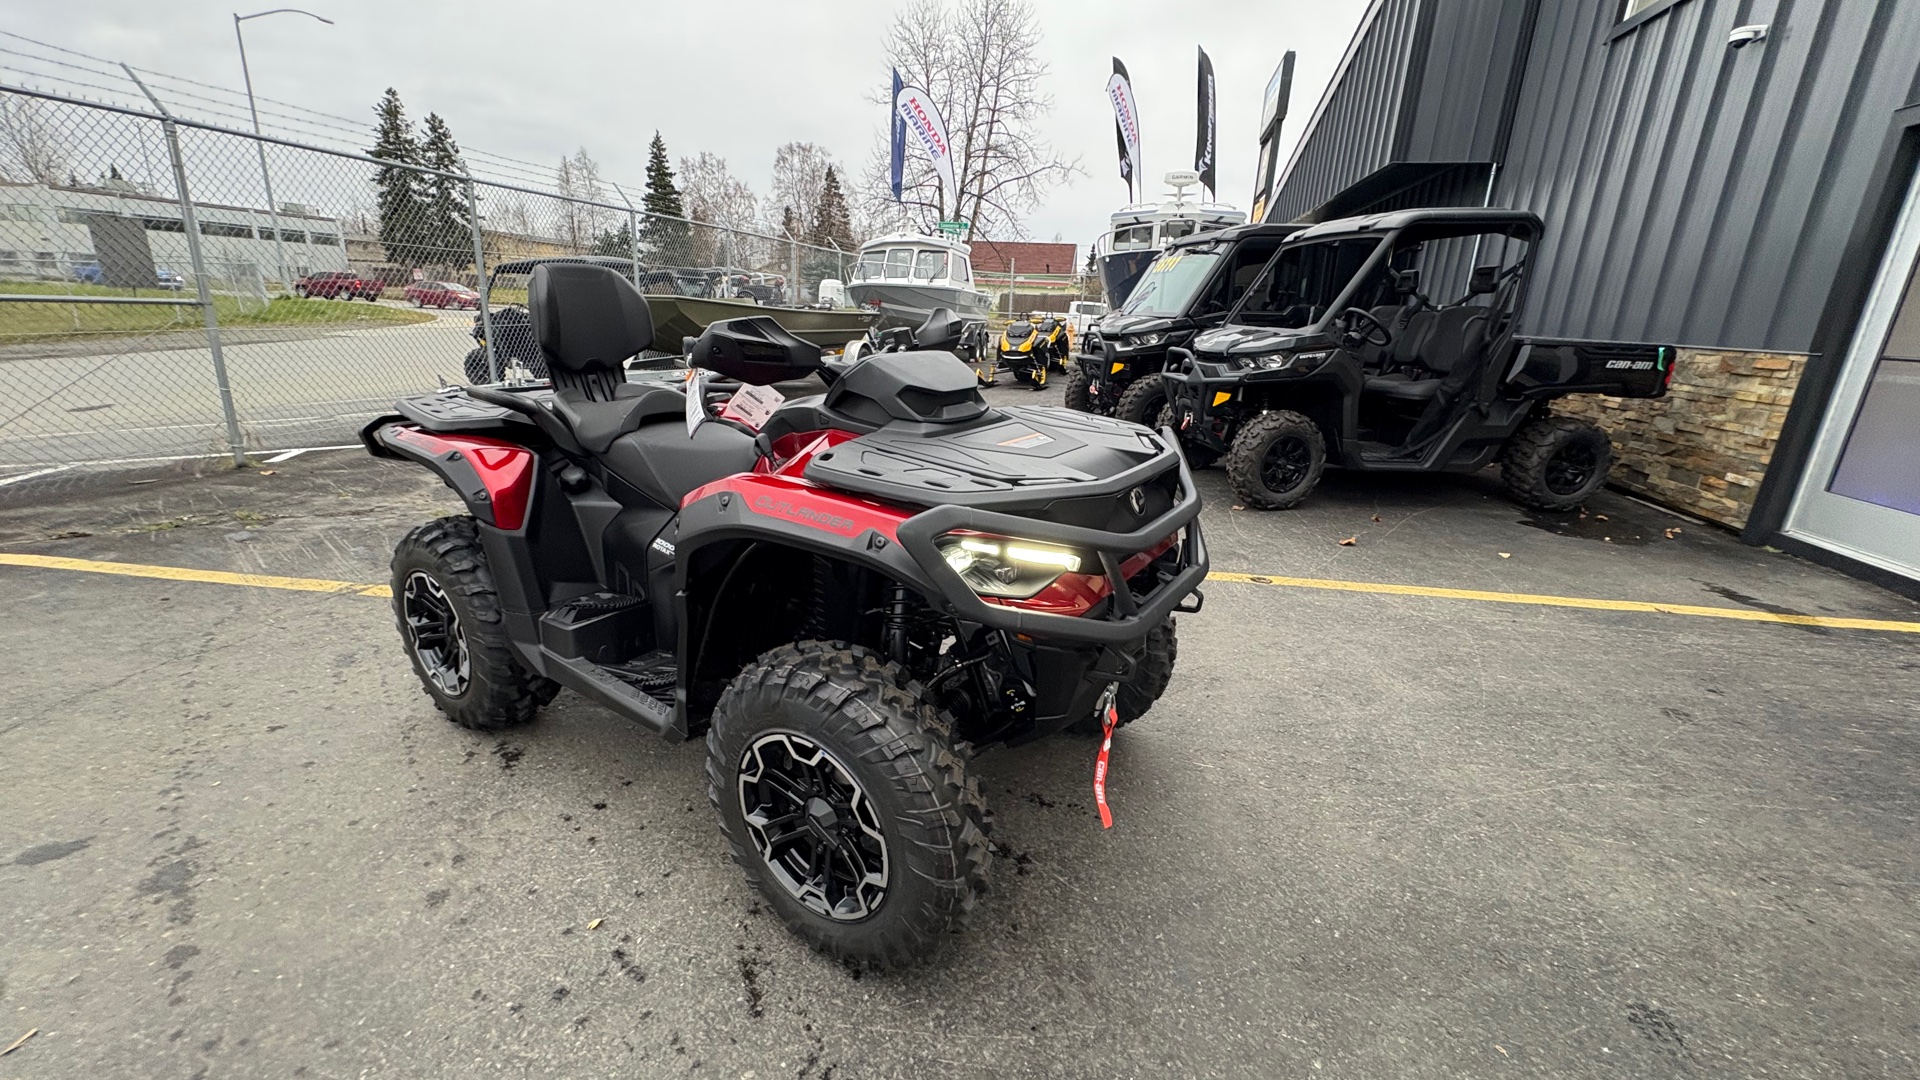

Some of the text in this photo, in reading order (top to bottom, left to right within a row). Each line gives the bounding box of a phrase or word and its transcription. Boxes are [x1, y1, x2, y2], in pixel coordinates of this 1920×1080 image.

[901, 102, 941, 161] MARINE
[909, 96, 947, 156] HONDA
[1117, 84, 1137, 145] HONDA
[1606, 361, 1654, 370] can-am
[755, 496, 853, 530] OUTLANDER
[652, 542, 670, 556] ROTAX
